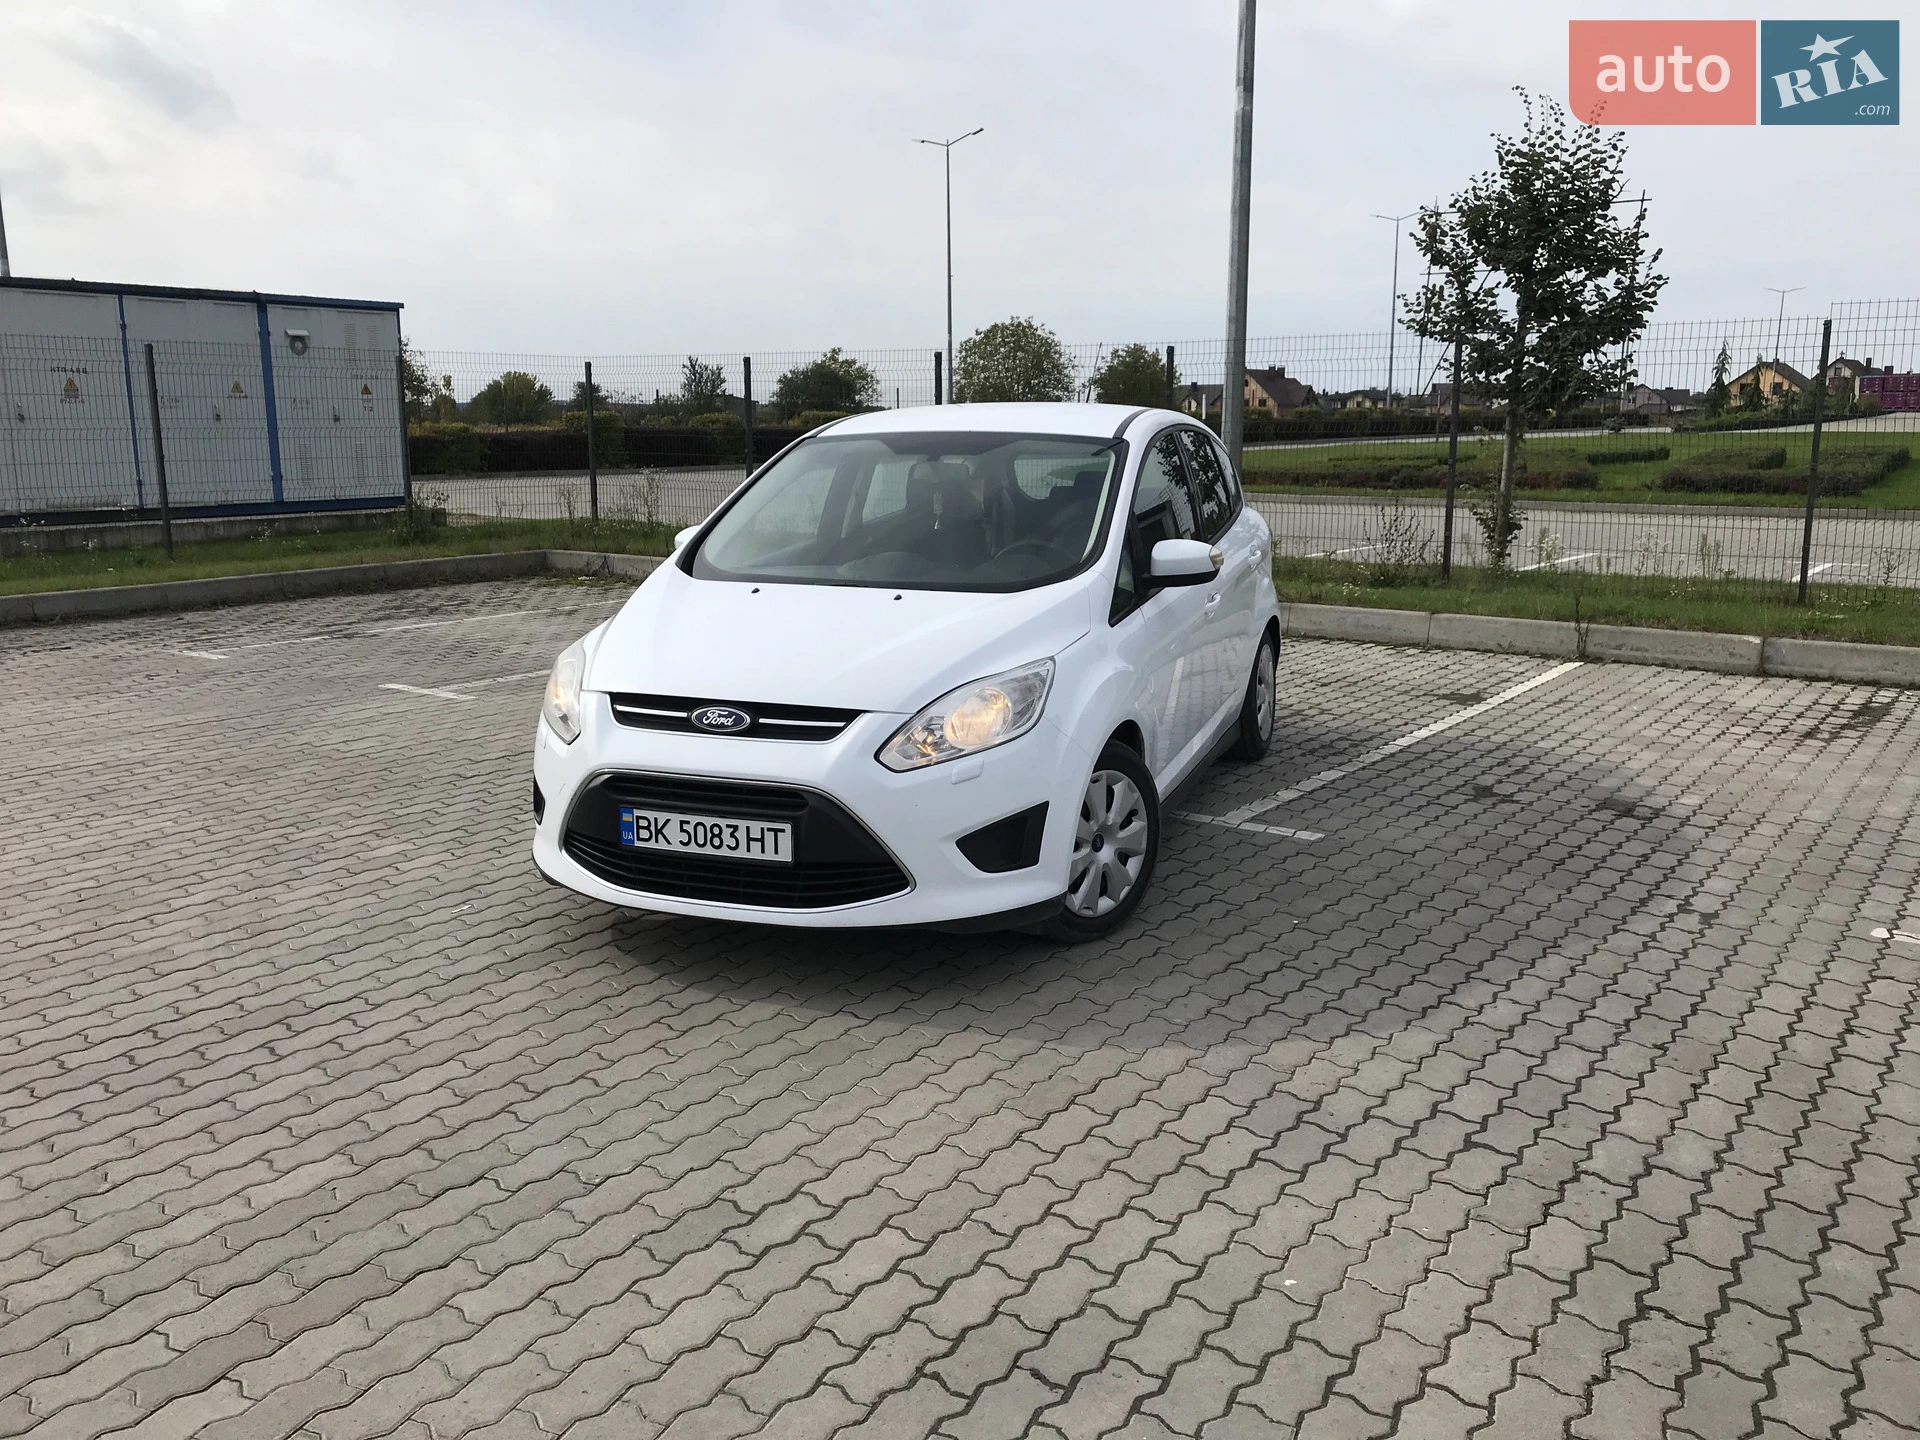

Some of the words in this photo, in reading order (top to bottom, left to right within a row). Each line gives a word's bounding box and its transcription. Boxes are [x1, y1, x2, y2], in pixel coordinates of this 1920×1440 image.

[702, 709, 736, 726] Ford
[622, 830, 634, 840] UA
[635, 815, 672, 845] BK
[678, 820, 740, 851] 5083
[745, 825, 786, 855] HT
